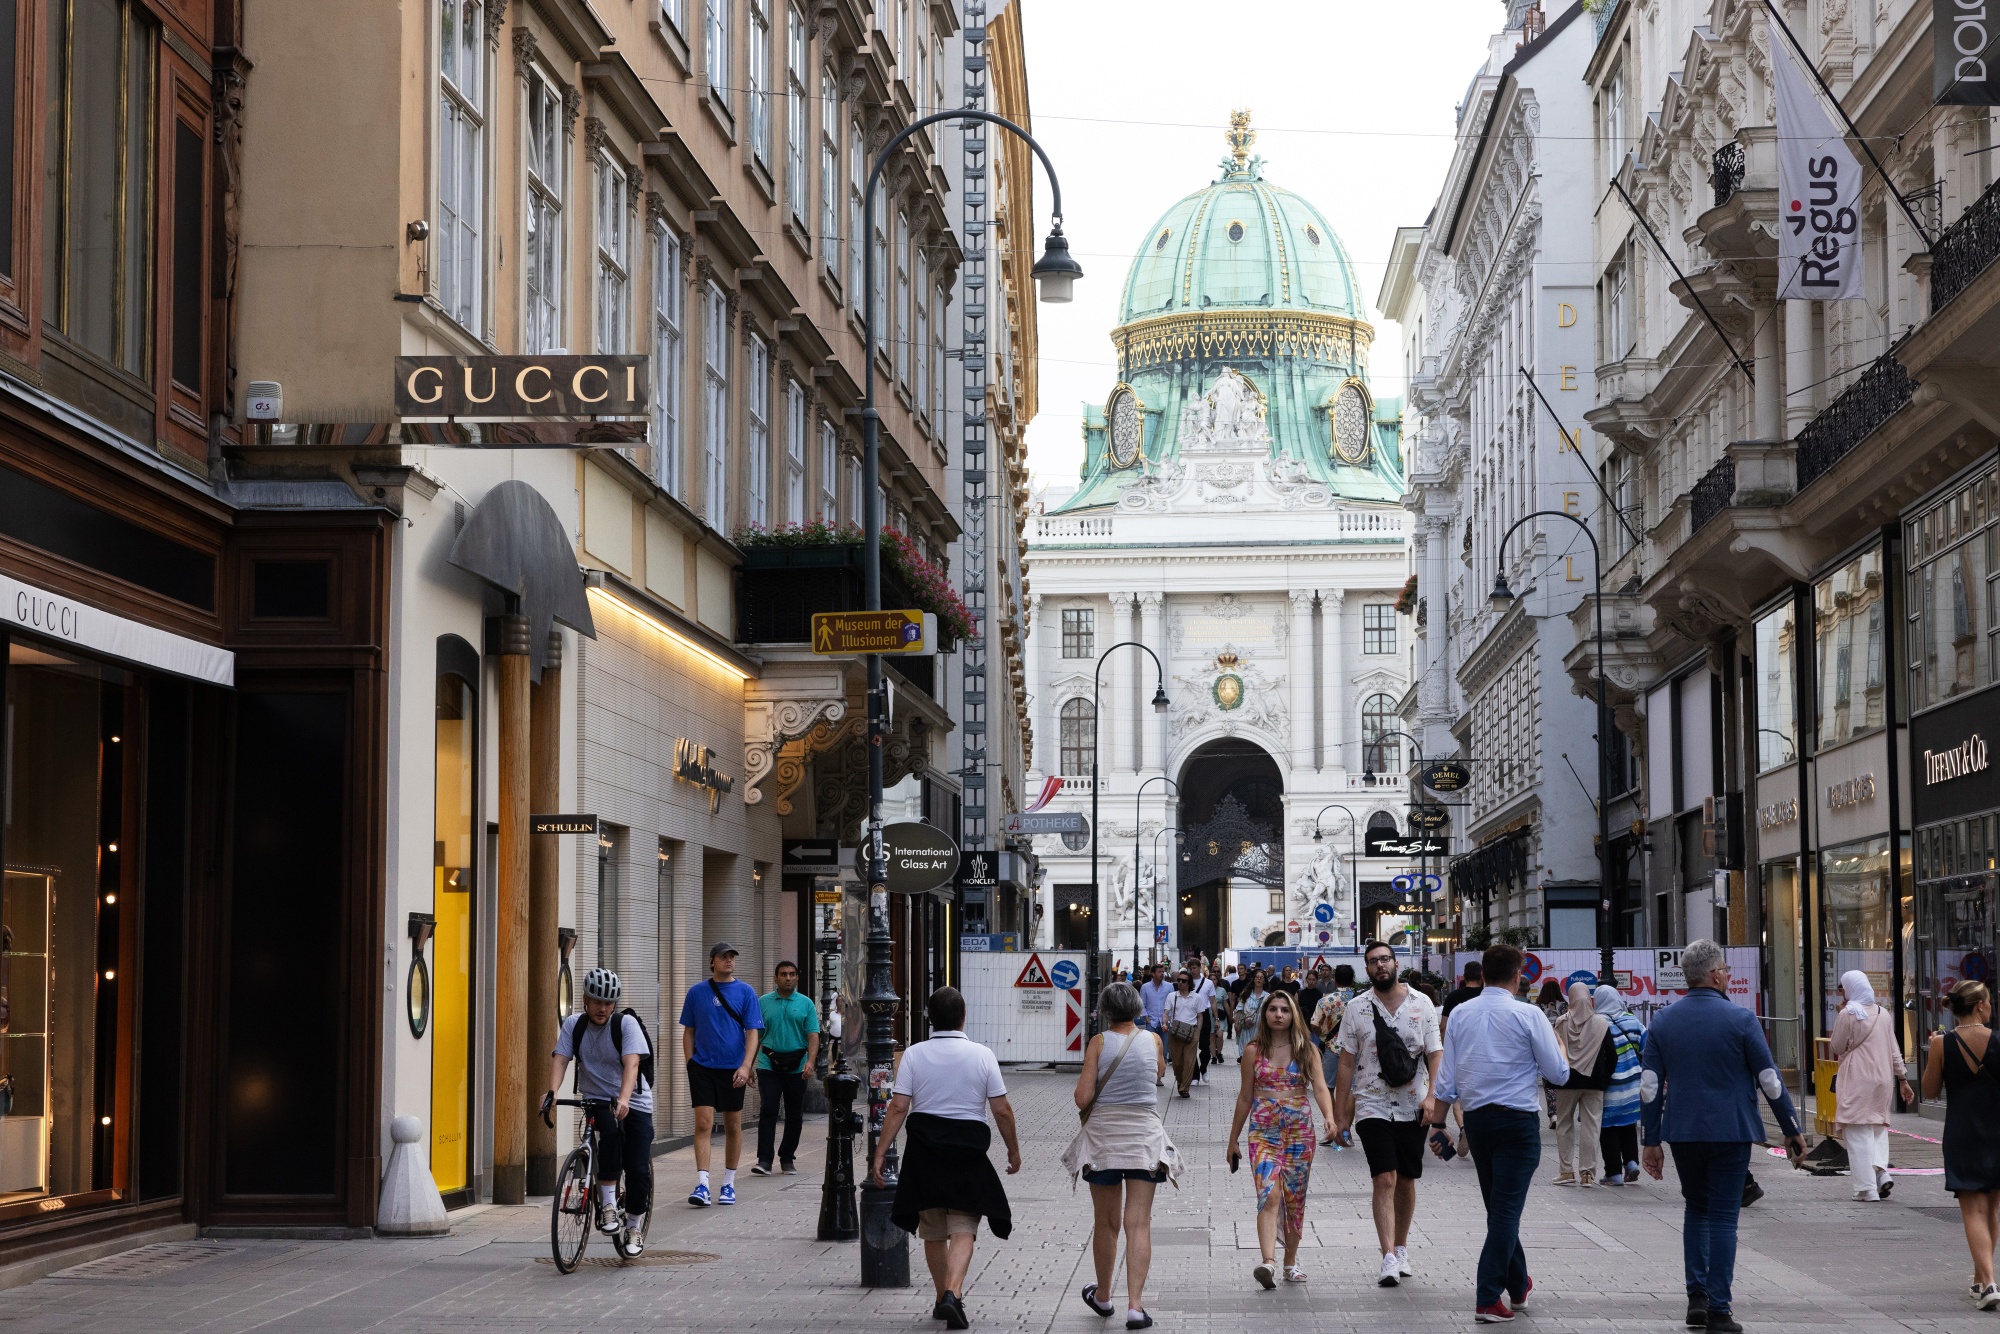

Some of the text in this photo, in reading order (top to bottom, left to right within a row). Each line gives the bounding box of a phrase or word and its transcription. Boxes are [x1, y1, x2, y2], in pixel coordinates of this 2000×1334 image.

[1801, 155, 1857, 288] Regus
[407, 365, 636, 404] GUCCI
[1558, 303, 1584, 582] DEMEL
[17, 591, 78, 639] GUCCI
[835, 618, 903, 632] Museum der
[841, 633, 897, 647] Illusionen
[1432, 771, 1460, 780] DEMEL
[537, 824, 594, 832] SCHULLIN
[1008, 816, 1079, 831] APOTHEKE
[895, 847, 953, 856] International
[1371, 839, 1408, 853] Thomas
[900, 859, 929, 869] Glass
[931, 860, 948, 869] Art
[1731, 977, 1749, 985] seit
